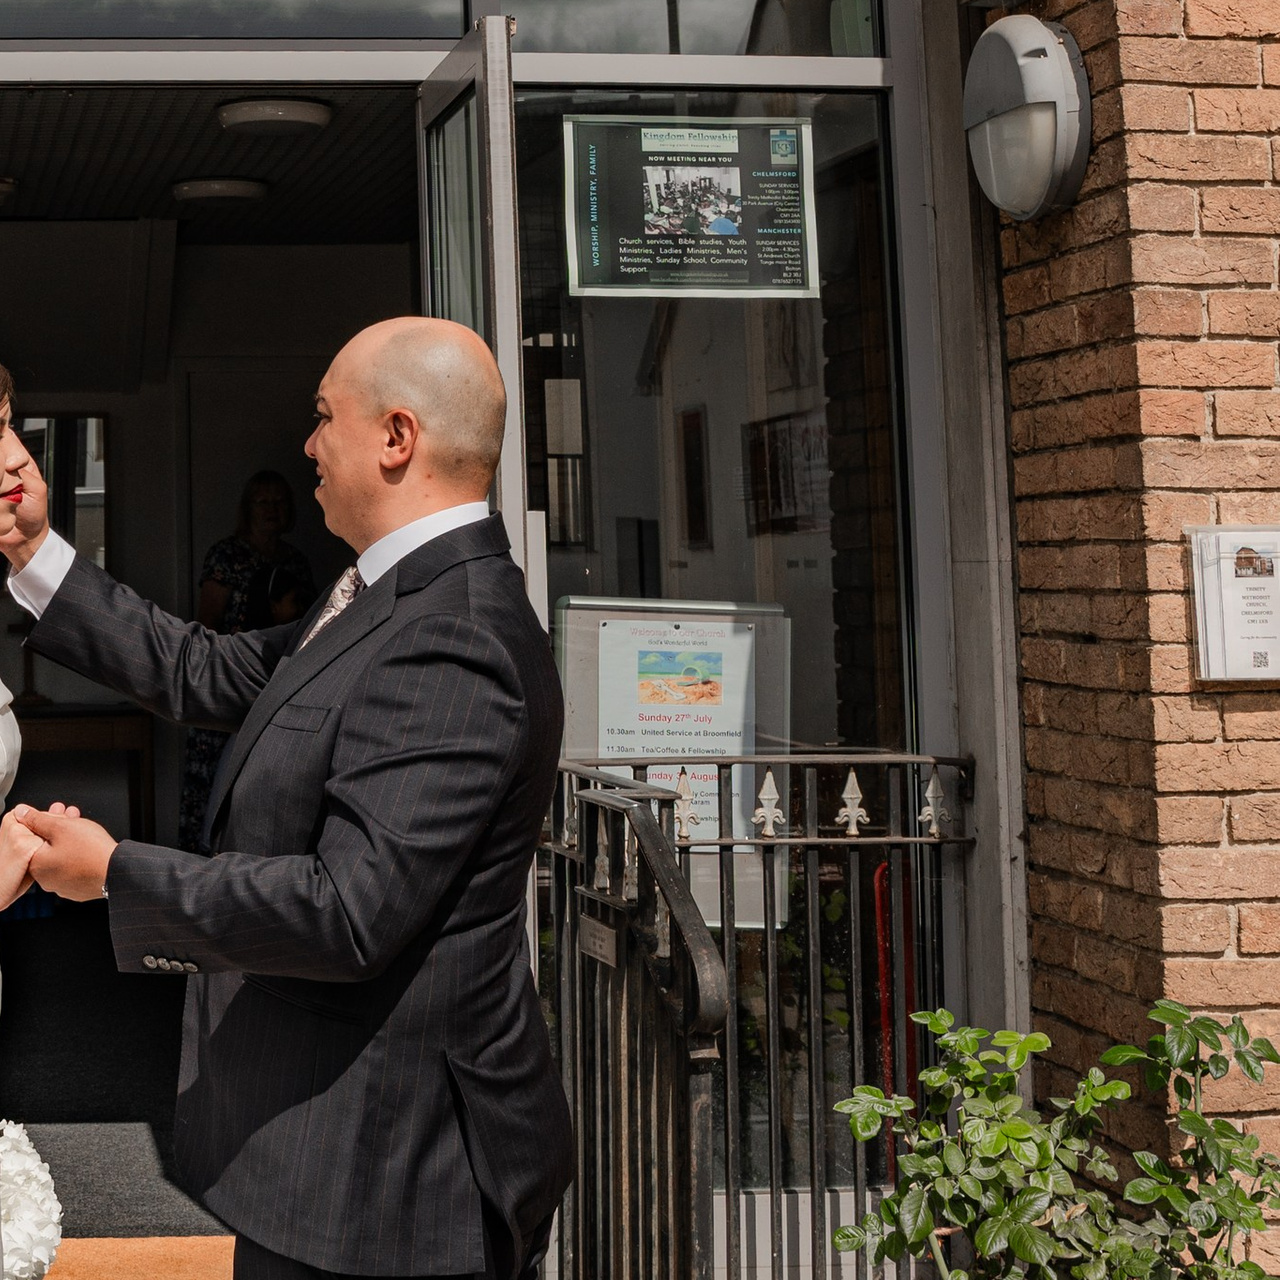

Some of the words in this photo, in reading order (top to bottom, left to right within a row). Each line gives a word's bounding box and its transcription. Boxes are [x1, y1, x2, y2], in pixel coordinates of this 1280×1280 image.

[643, 131, 685, 142] Kingdom
[687, 132, 738, 143] Fellowship
[589, 178, 598, 221] MINISTRY,
[590, 225, 600, 267] WORSHIP,
[619, 237, 642, 245] Church
[646, 238, 674, 246] services,
[699, 238, 724, 246] studies,
[619, 247, 655, 255] Ministries,
[619, 256, 653, 264] Ministries,
[656, 256, 680, 265] Sunday
[683, 256, 707, 264] School,
[710, 257, 748, 266] Community
[630, 627, 667, 637] Welcome
[696, 628, 726, 638] Church
[638, 713, 672, 724] Sunday
[675, 713, 691, 722] 27th
[693, 714, 713, 724] July
[666, 729, 693, 737] Service
[702, 730, 742, 738] Broomfield
[641, 746, 679, 754] Tea/Coffee
[688, 747, 727, 756] Fellowship
[647, 772, 673, 781] unday
[690, 772, 719, 782] Augus
